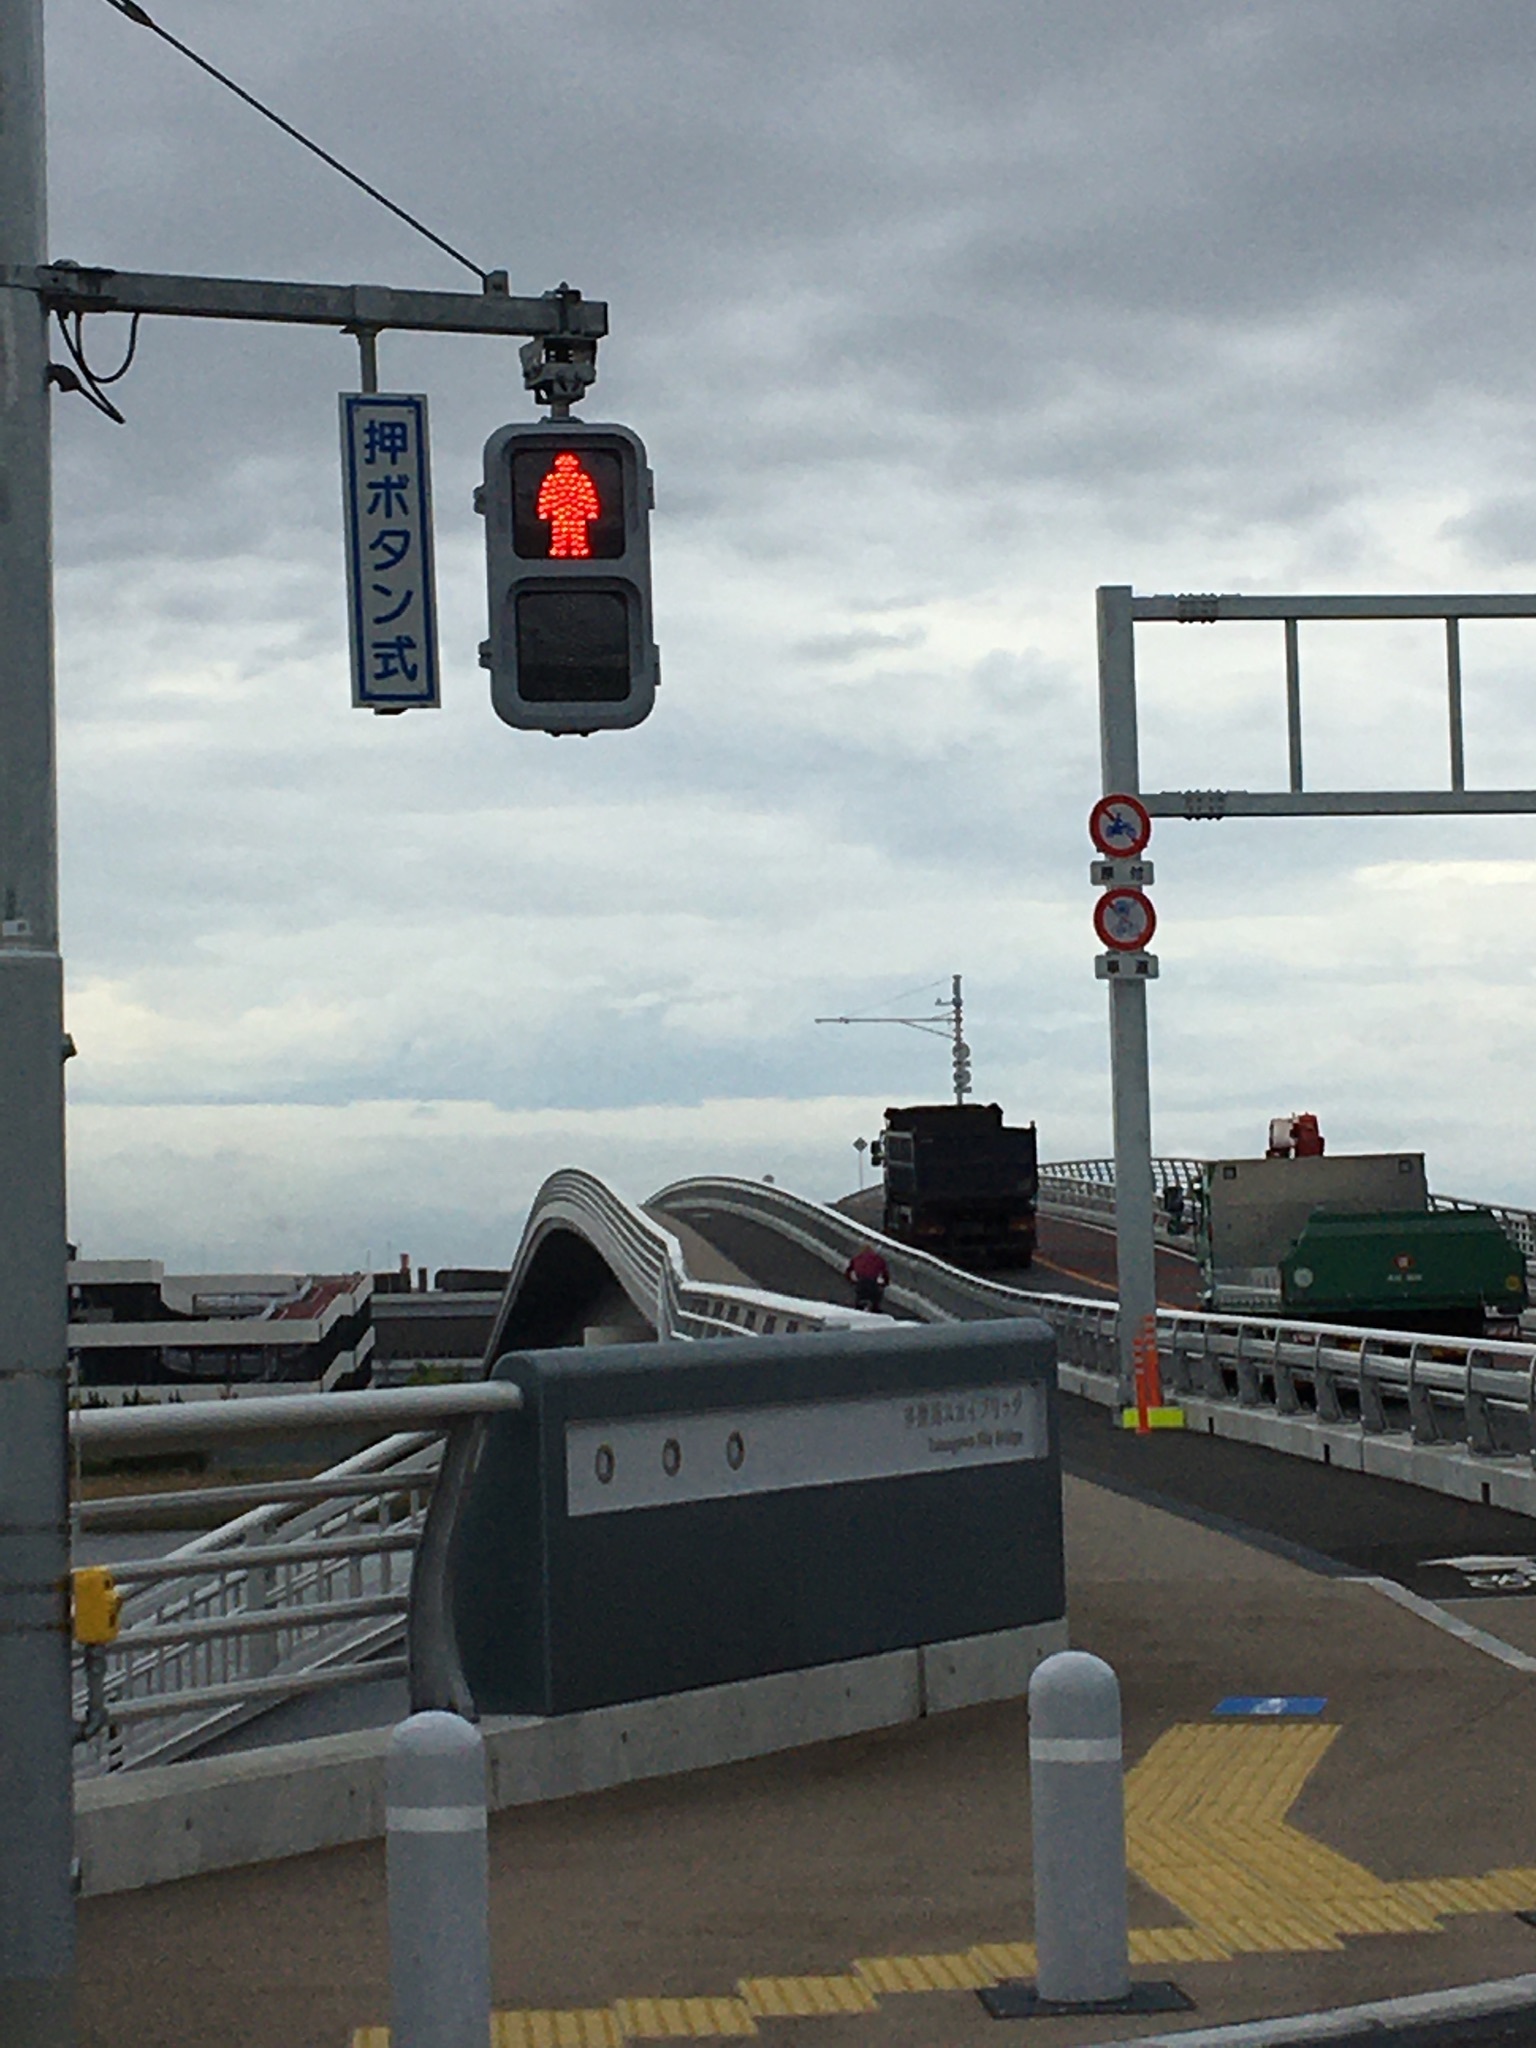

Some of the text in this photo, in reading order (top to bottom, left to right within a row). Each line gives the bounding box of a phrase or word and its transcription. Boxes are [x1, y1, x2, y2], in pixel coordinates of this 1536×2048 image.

[363, 419, 418, 682] 押ボタン式
